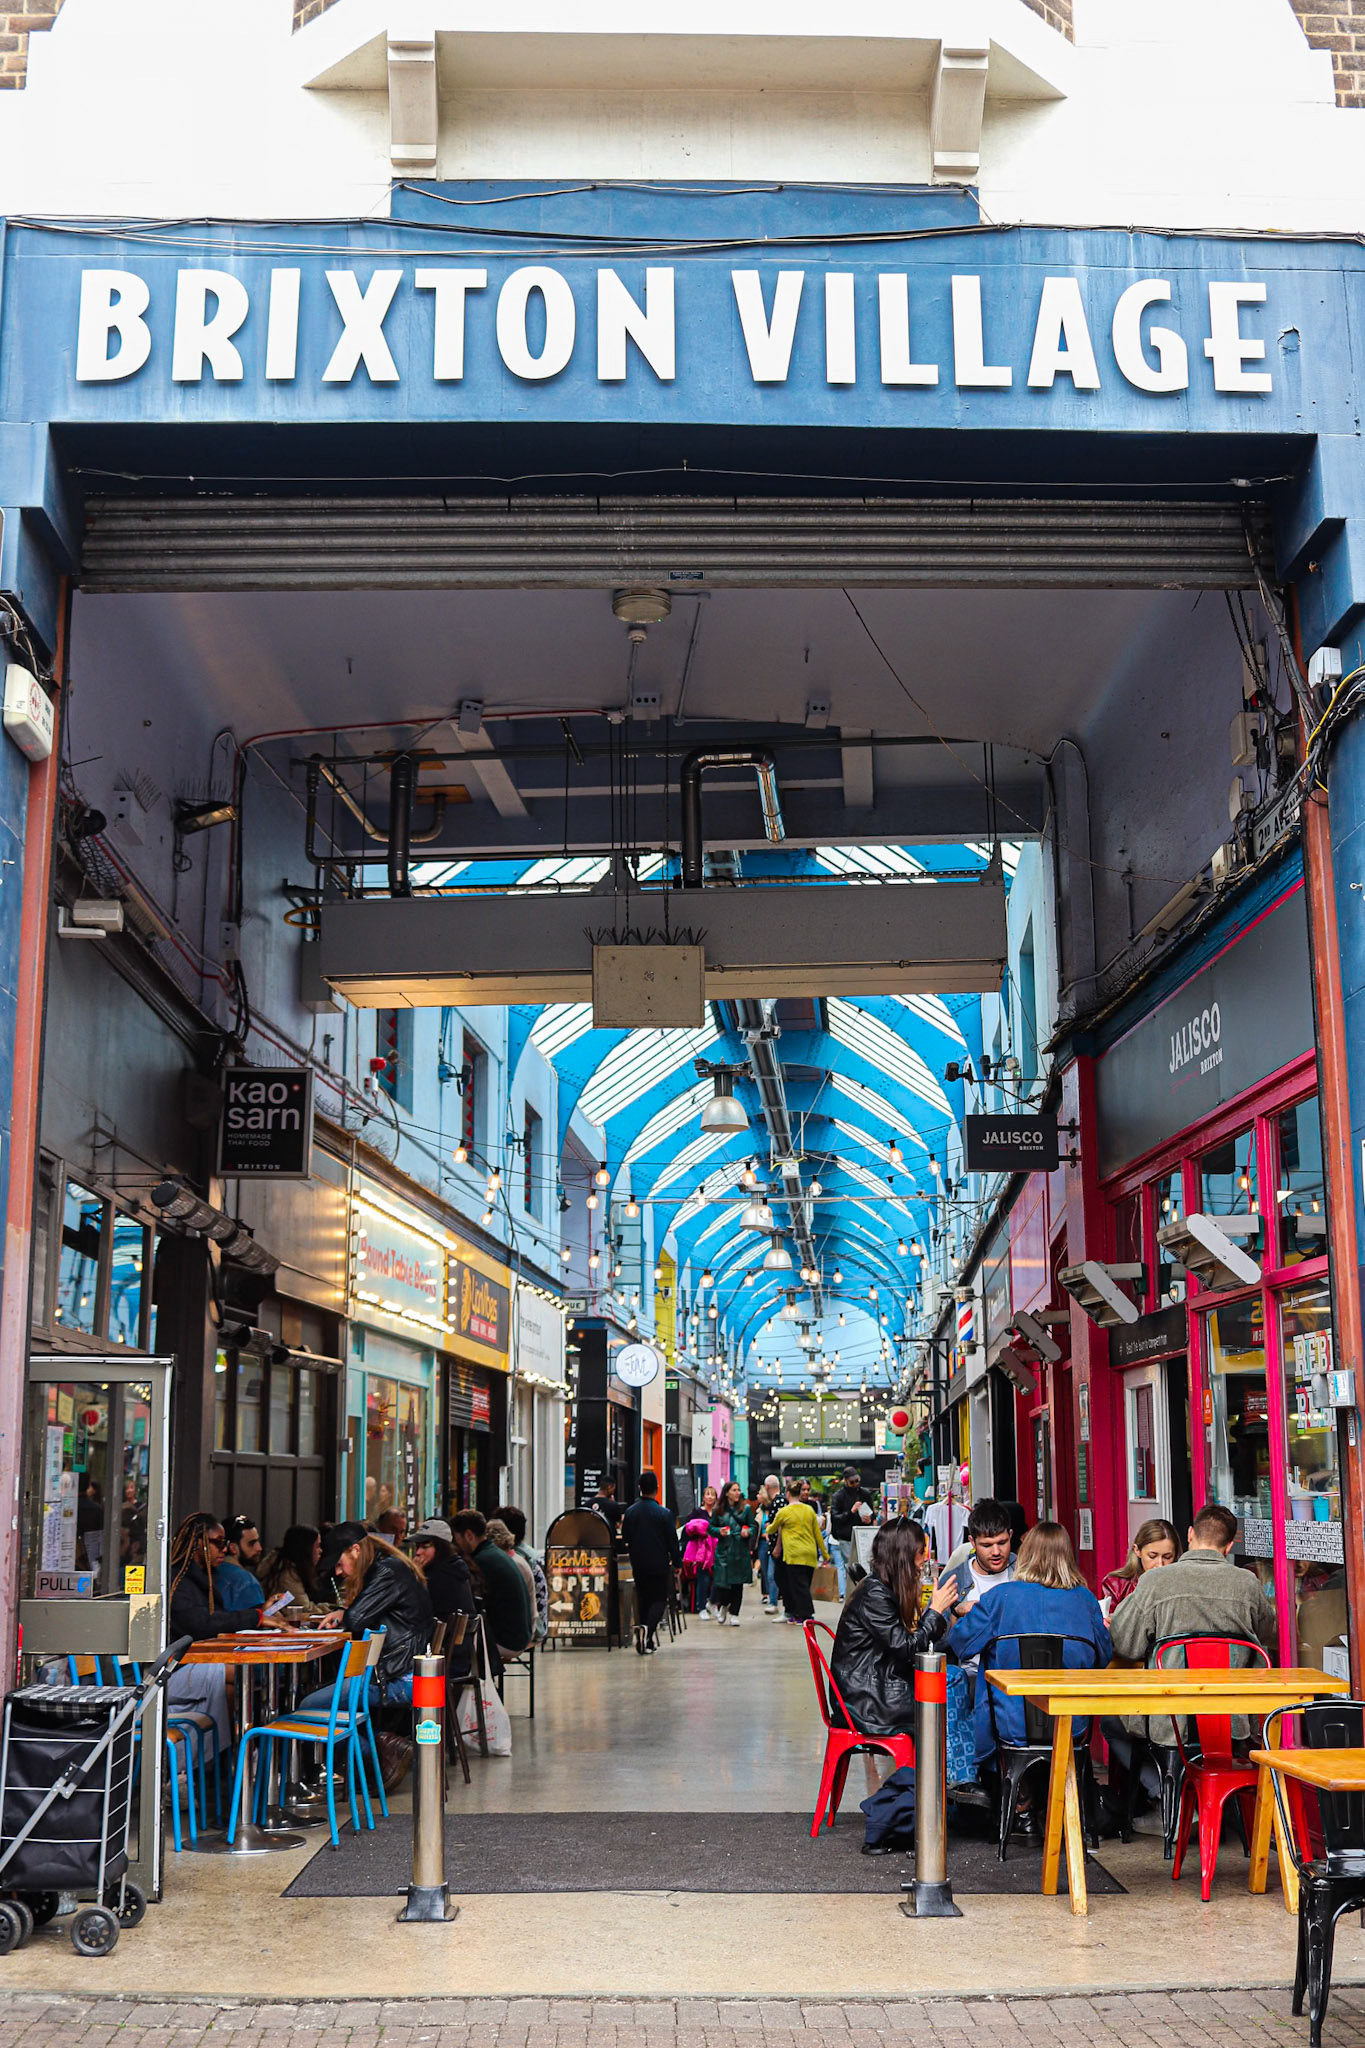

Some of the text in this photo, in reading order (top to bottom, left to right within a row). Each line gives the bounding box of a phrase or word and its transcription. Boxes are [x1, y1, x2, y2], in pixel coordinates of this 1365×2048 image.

[76, 266, 1273, 394] BRIXTON VILLAGE
[1169, 1002, 1221, 1074] JALISCO
[1200, 1047, 1223, 1075] BRIXTON
[227, 1107, 300, 1130] sarn
[982, 1131, 1043, 1144] JALISCO
[360, 1236, 437, 1298] Round Table Books
[40, 1577, 75, 1591] PULL
[552, 1576, 605, 1592] OPEN
